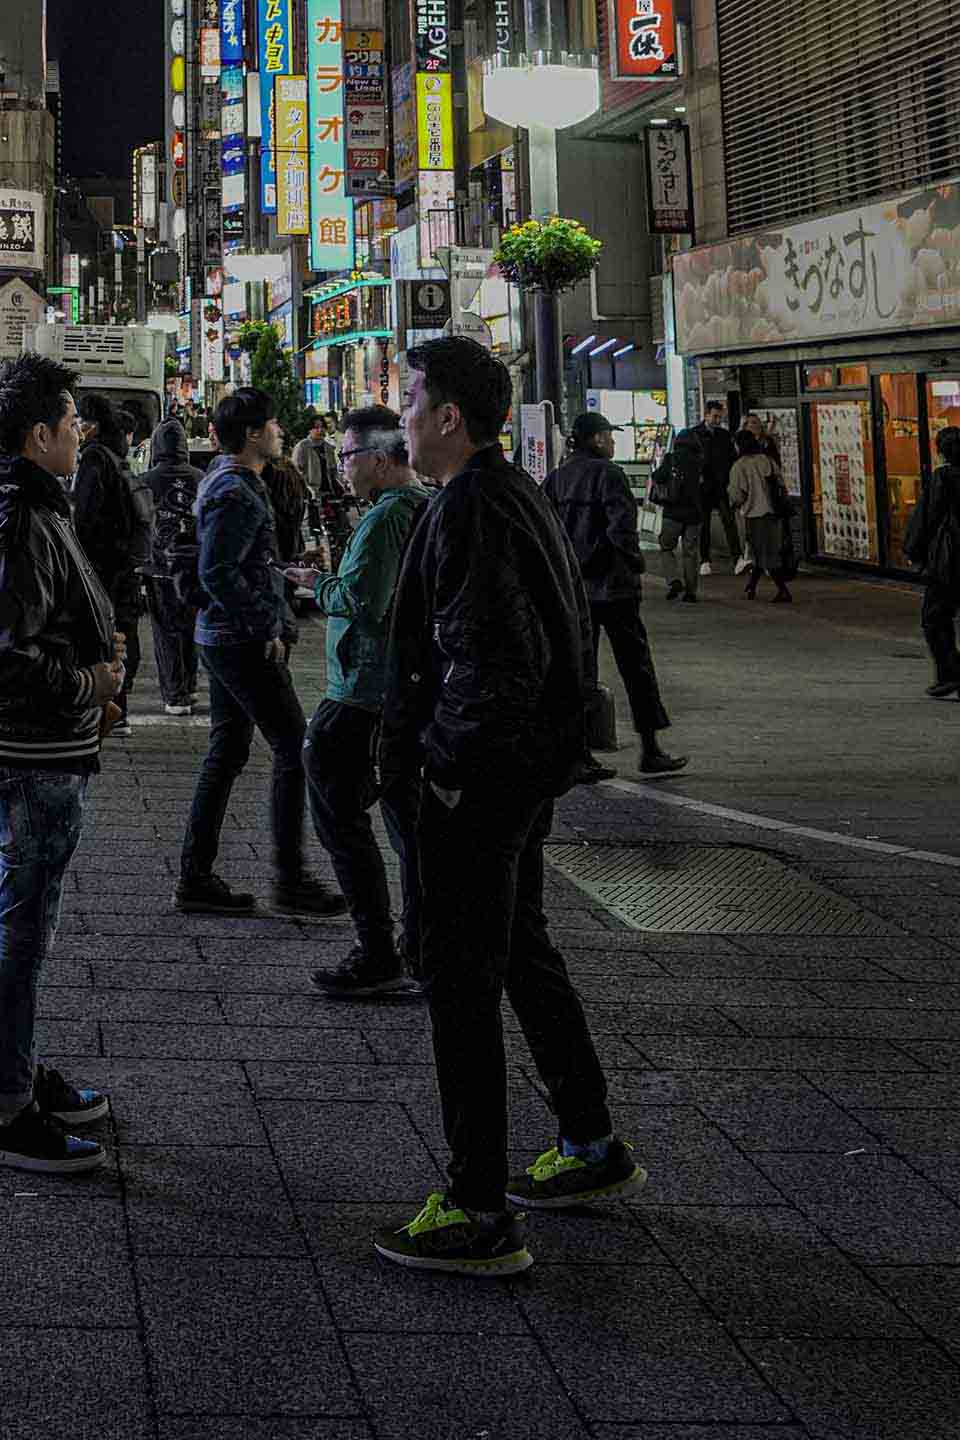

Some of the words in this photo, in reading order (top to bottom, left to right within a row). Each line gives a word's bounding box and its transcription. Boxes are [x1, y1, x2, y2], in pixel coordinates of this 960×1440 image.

[628, 14, 662, 59] 一休
[316, 16, 346, 246] カラオケ館
